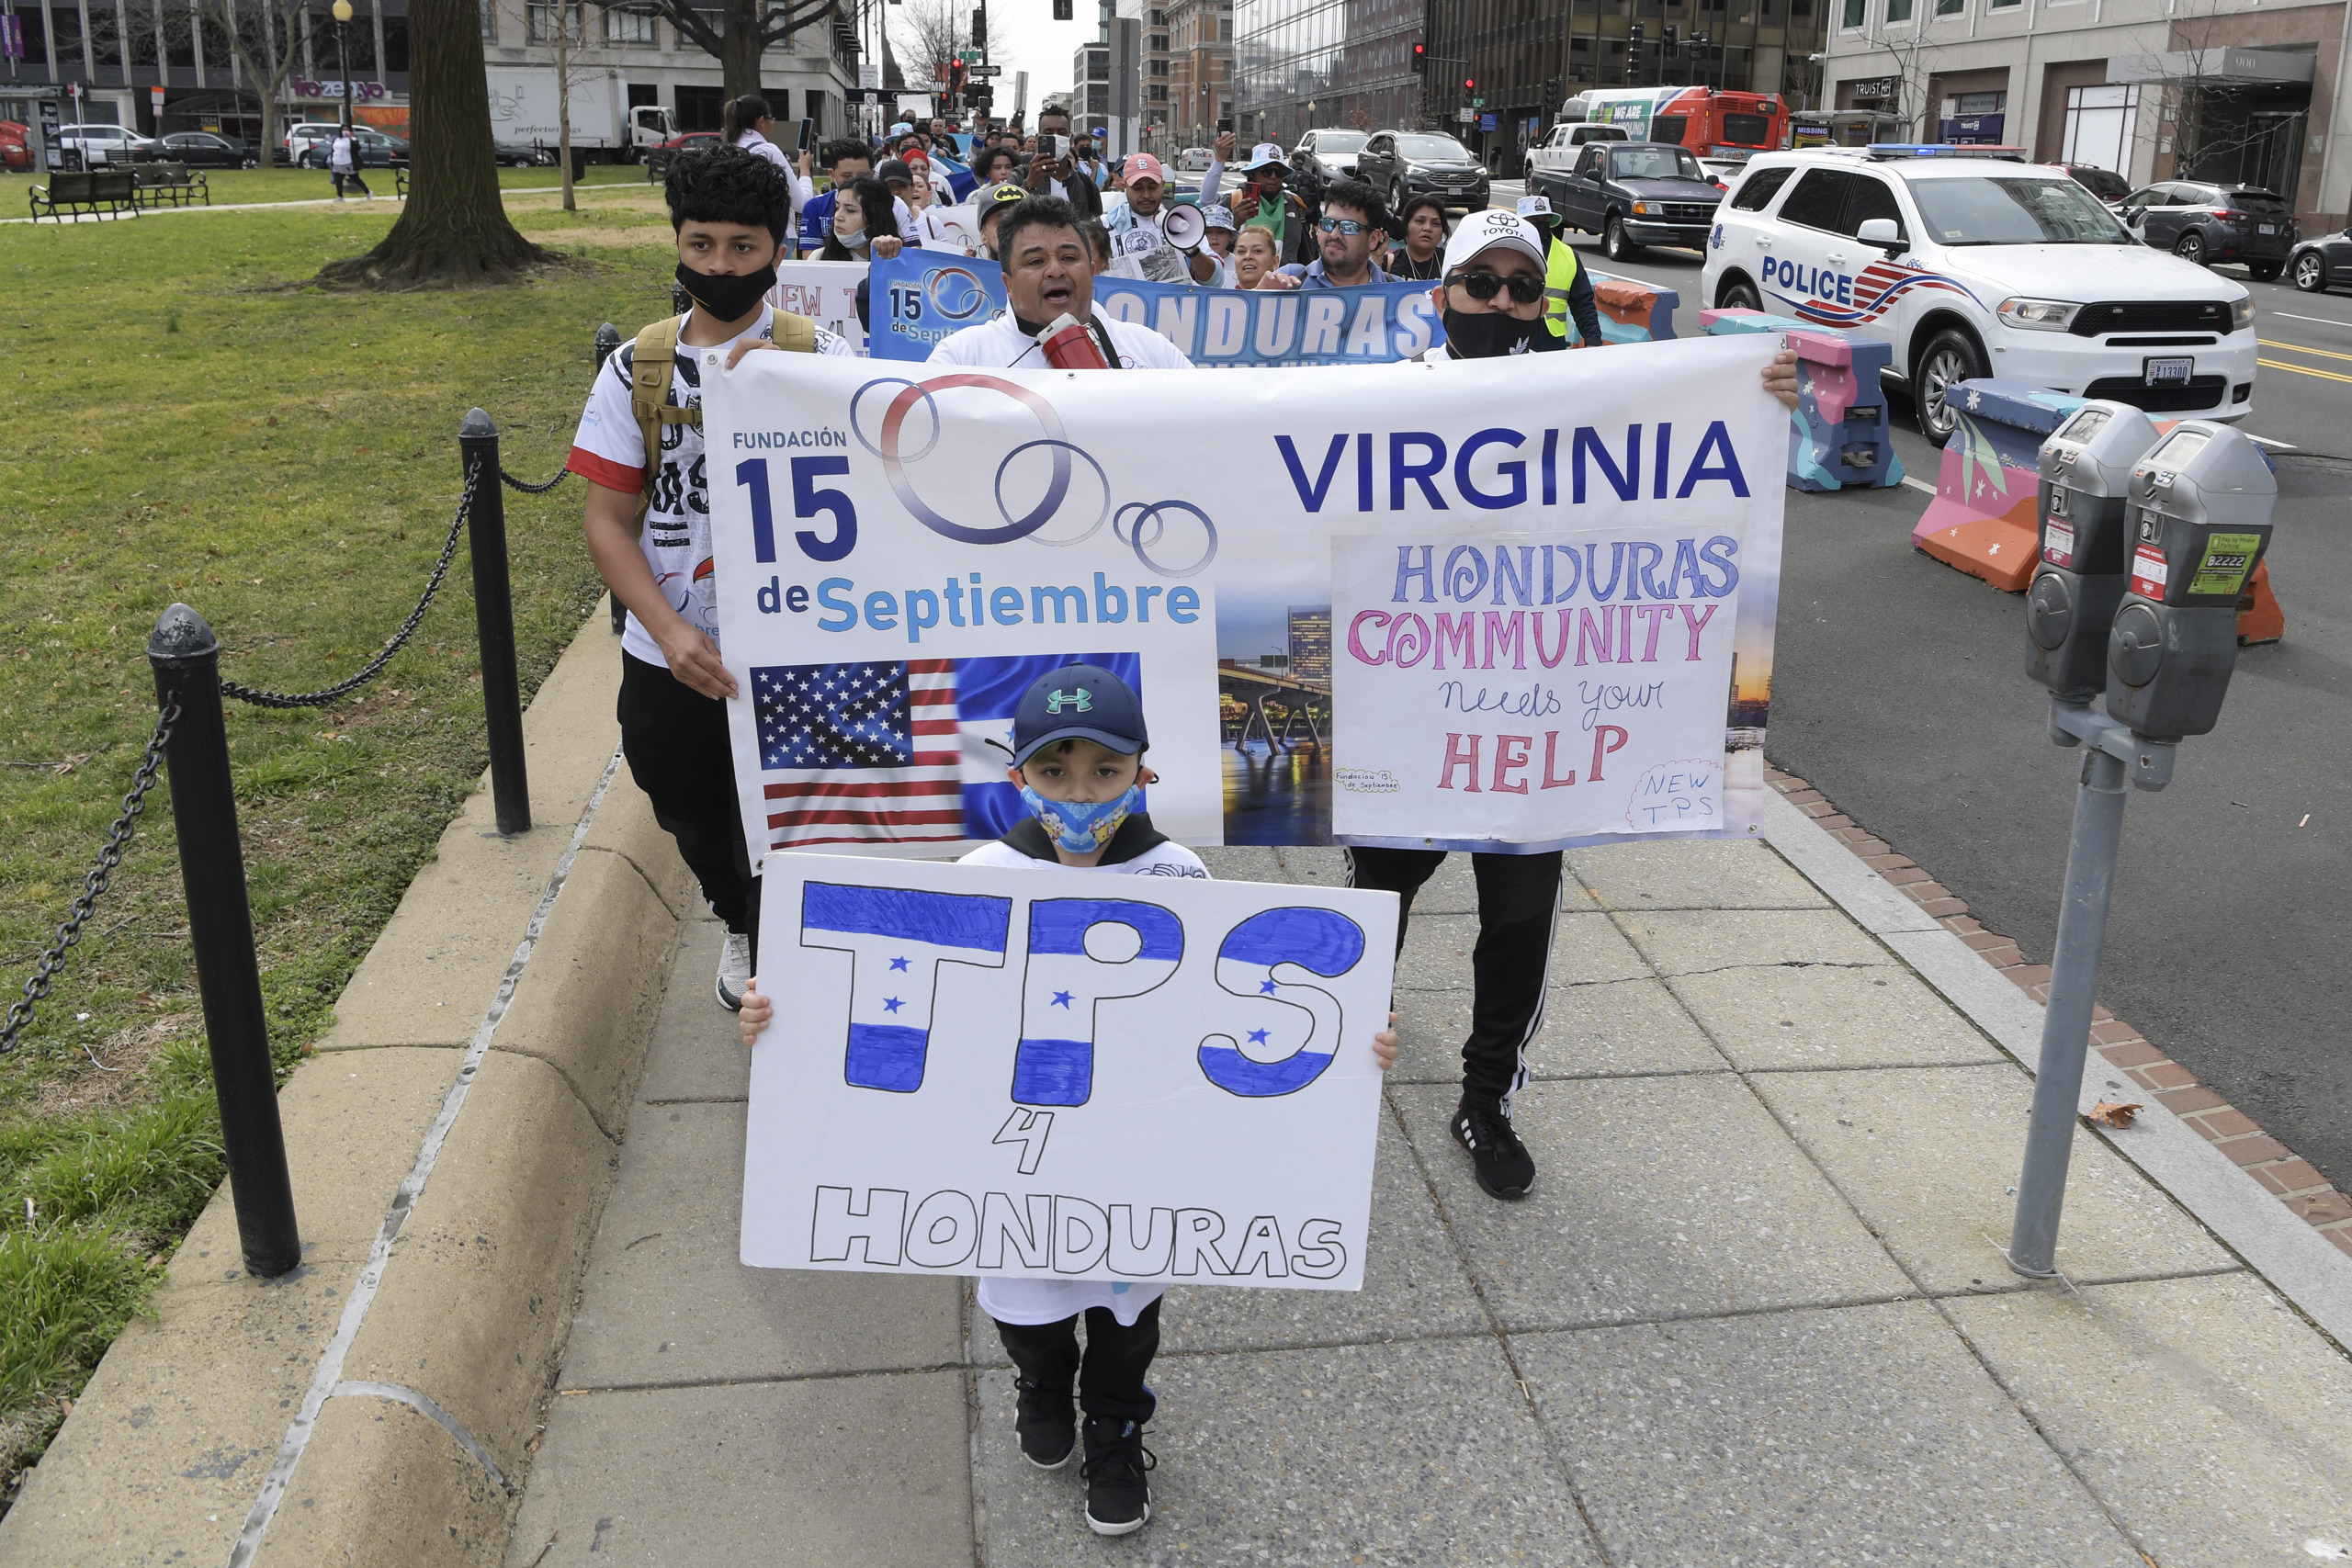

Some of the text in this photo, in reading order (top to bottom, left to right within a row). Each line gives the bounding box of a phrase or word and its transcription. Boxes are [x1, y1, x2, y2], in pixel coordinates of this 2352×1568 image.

[2235, 56, 2256, 69] 900
[1856, 82, 1881, 96] TRUIST
[1613, 105, 1643, 120] WE ARE
[514, 124, 582, 135] perfectsetngs
[1797, 127, 1828, 135] MISSING
[1482, 227, 1525, 239] TOYOTA
[889, 280, 922, 289] FUNDACIÓN
[1761, 255, 1852, 306] POLICE
[889, 288, 922, 321] 15
[732, 426, 847, 449] FUNDACIÓN
[1273, 420, 1751, 513] VIRGINIA
[735, 456, 858, 564] 15
[1390, 535, 1740, 607] HONDURAS
[1347, 604, 1719, 671] COMMUNITY
[1437, 724, 1629, 795] HELP
[1644, 773, 1710, 797] NEW
[799, 879, 1366, 1108] TPS
[991, 1106, 1055, 1175] 4
[809, 1185, 1348, 1280] HONDURAS
